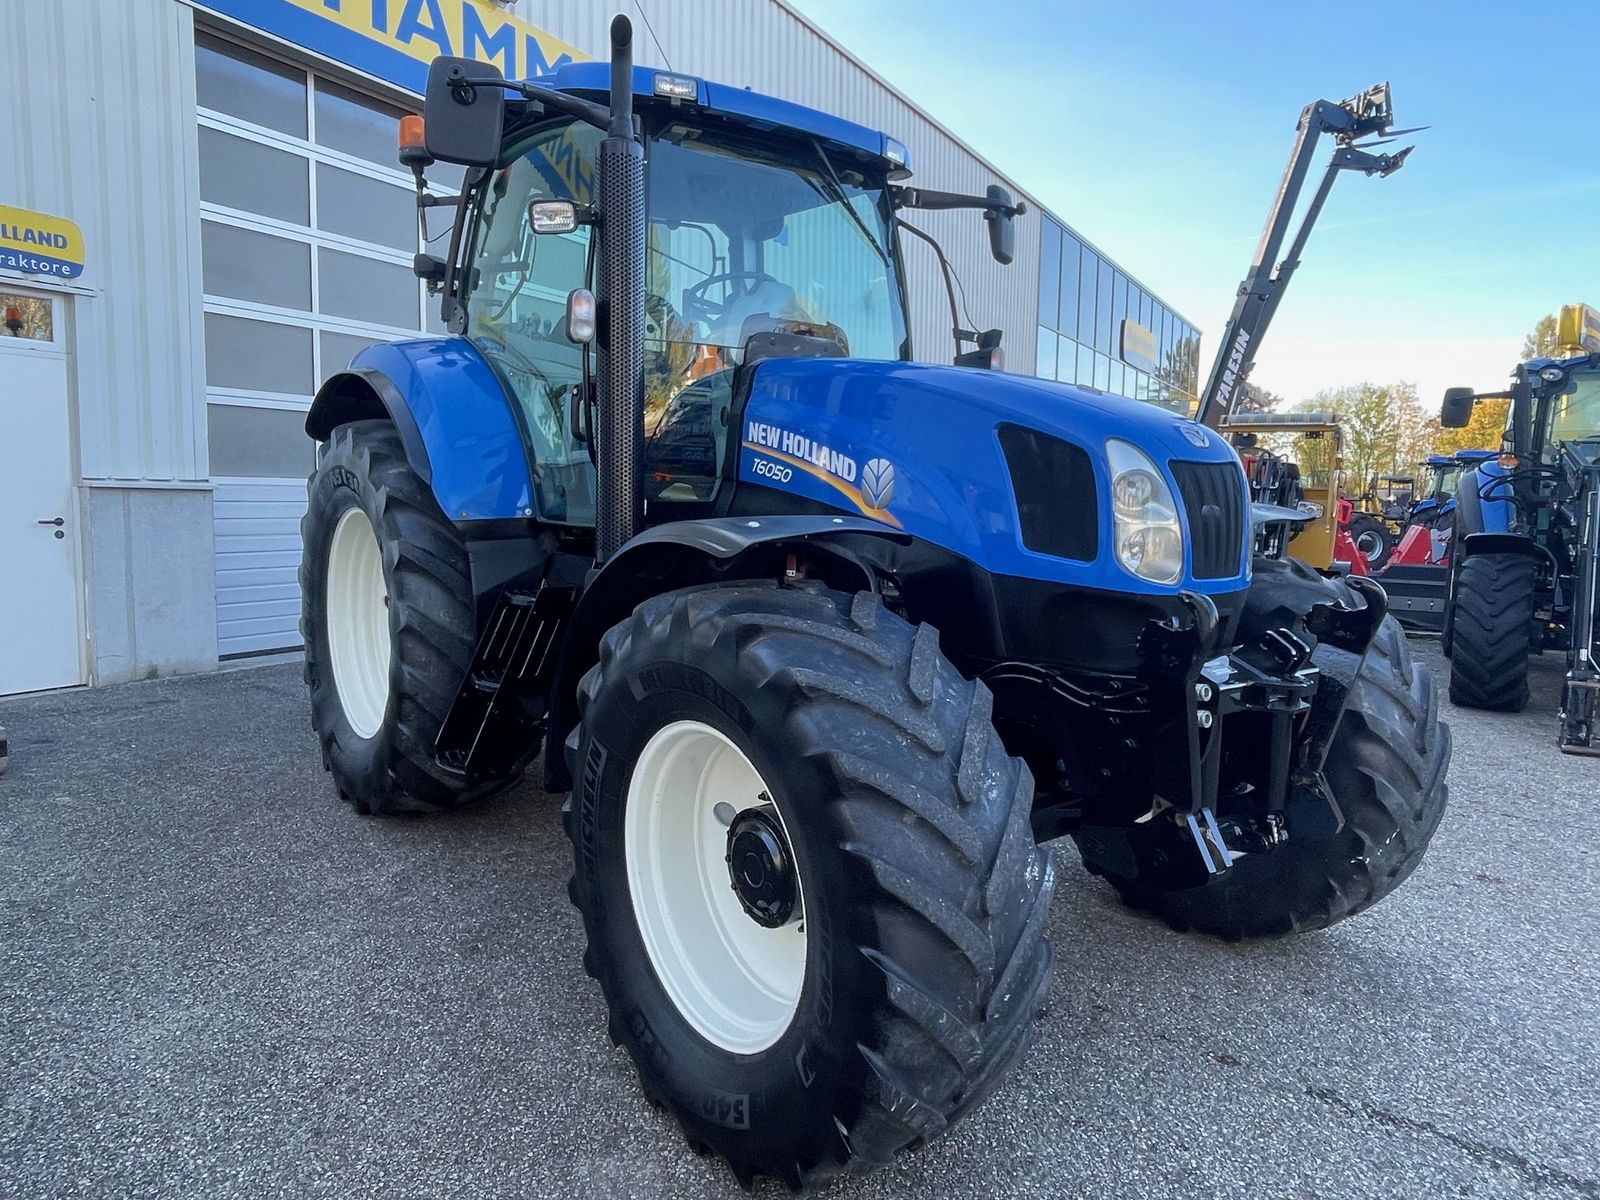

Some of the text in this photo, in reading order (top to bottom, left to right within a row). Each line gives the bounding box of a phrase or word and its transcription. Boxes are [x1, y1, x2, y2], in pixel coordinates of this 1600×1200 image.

[1216, 328, 1250, 408] FARESIN
[748, 421, 857, 483] NEW HOLLAND
[751, 457, 793, 483] T6050
